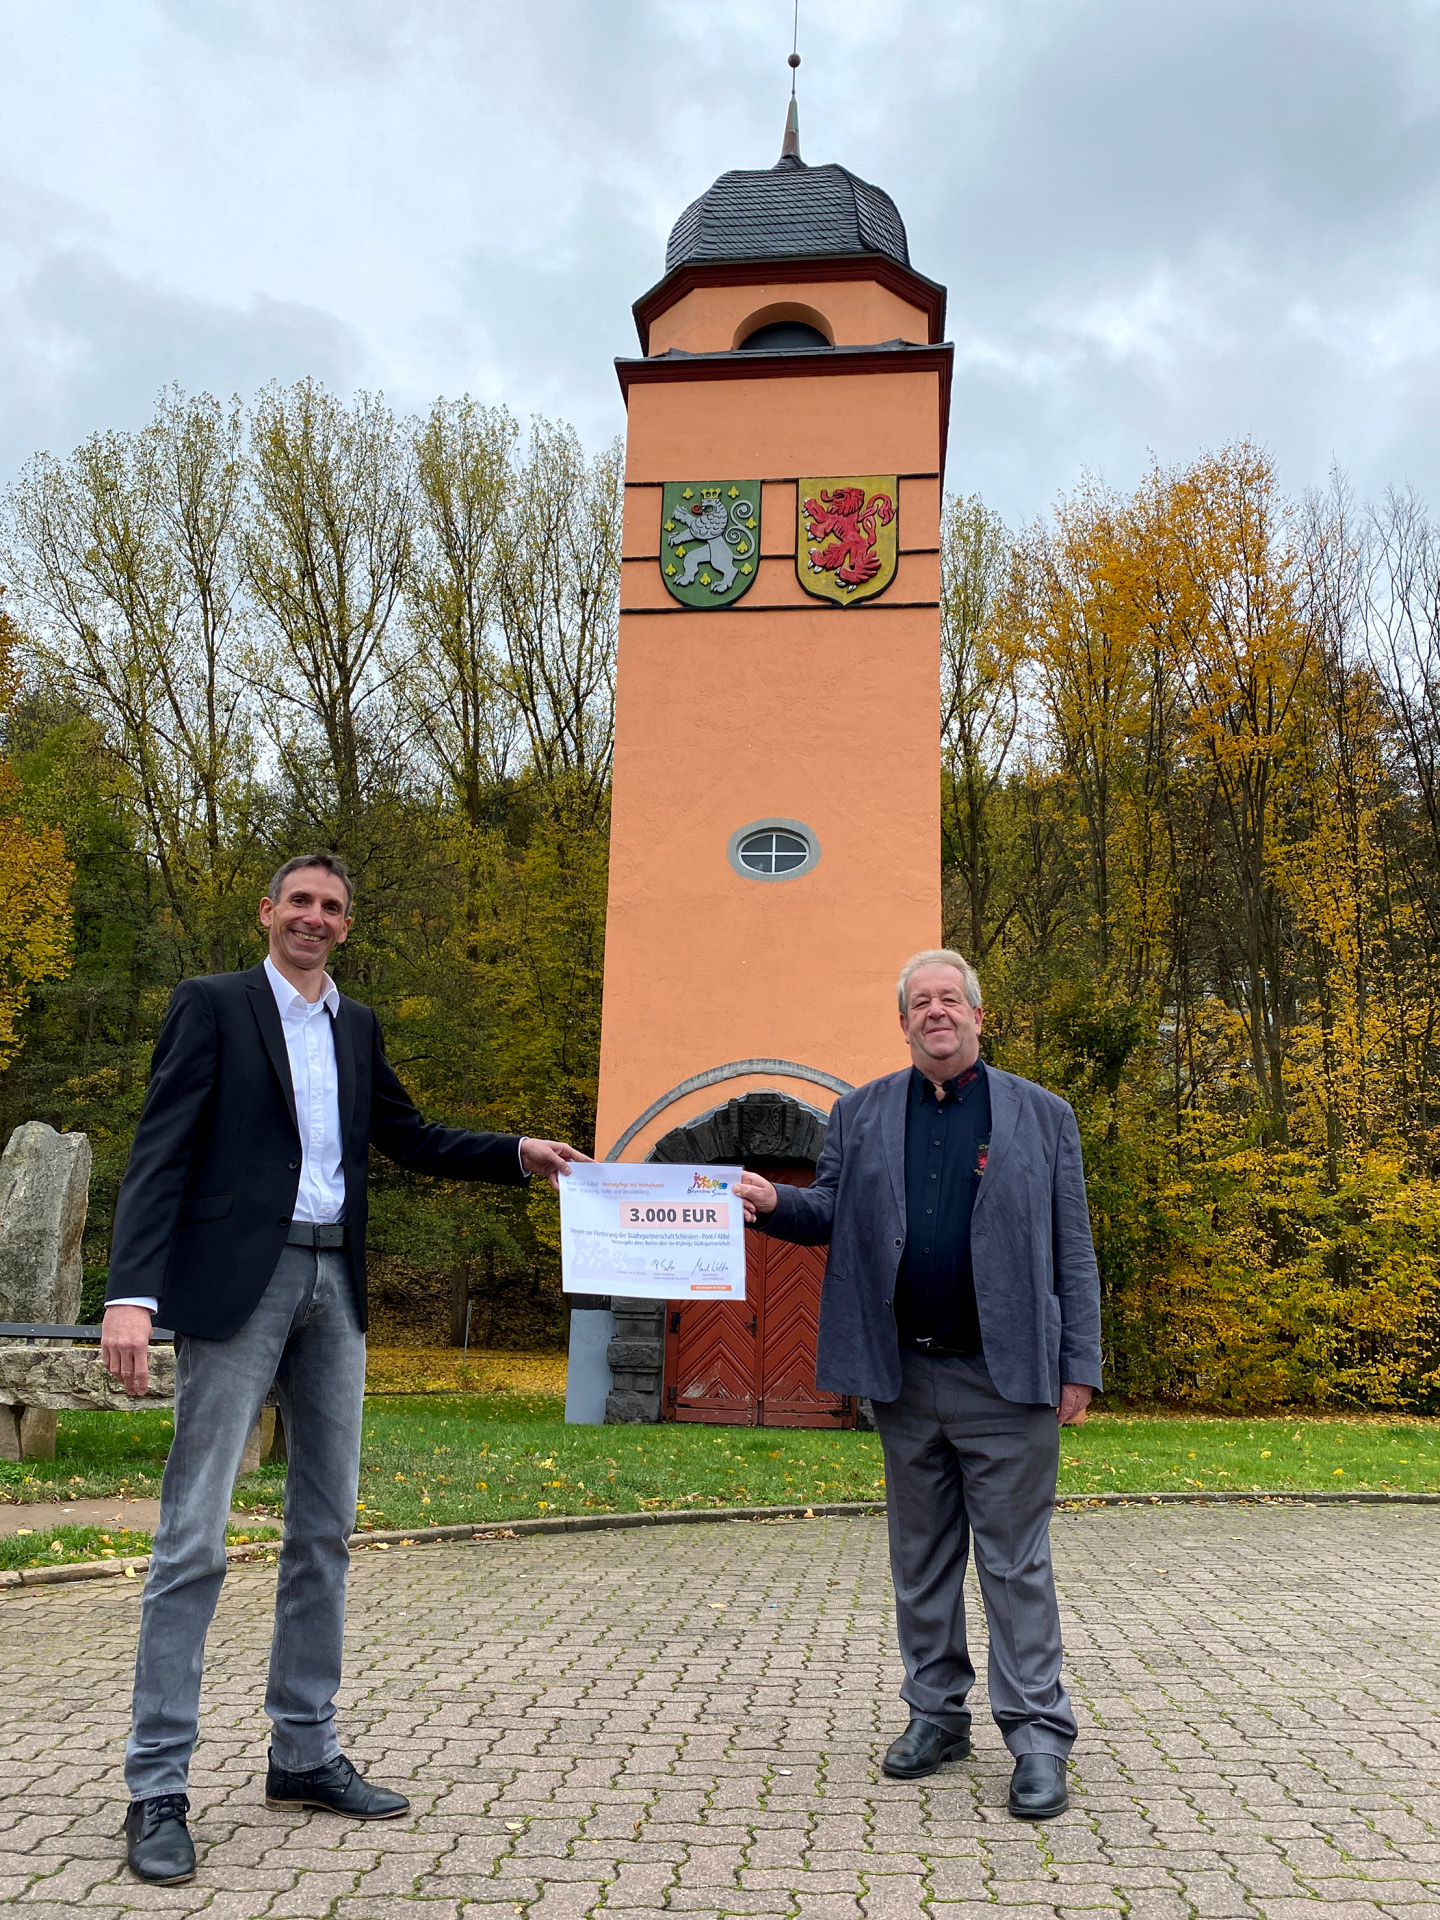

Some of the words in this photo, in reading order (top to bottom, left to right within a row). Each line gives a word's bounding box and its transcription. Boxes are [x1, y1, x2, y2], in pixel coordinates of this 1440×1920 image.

[630, 1208, 677, 1223] 3.000
[682, 1208, 718, 1223] EUR
[594, 1230, 618, 1239] Förderung
[628, 1232, 674, 1240] Städtepartnerschaft
[674, 1232, 699, 1240] Schleiden
